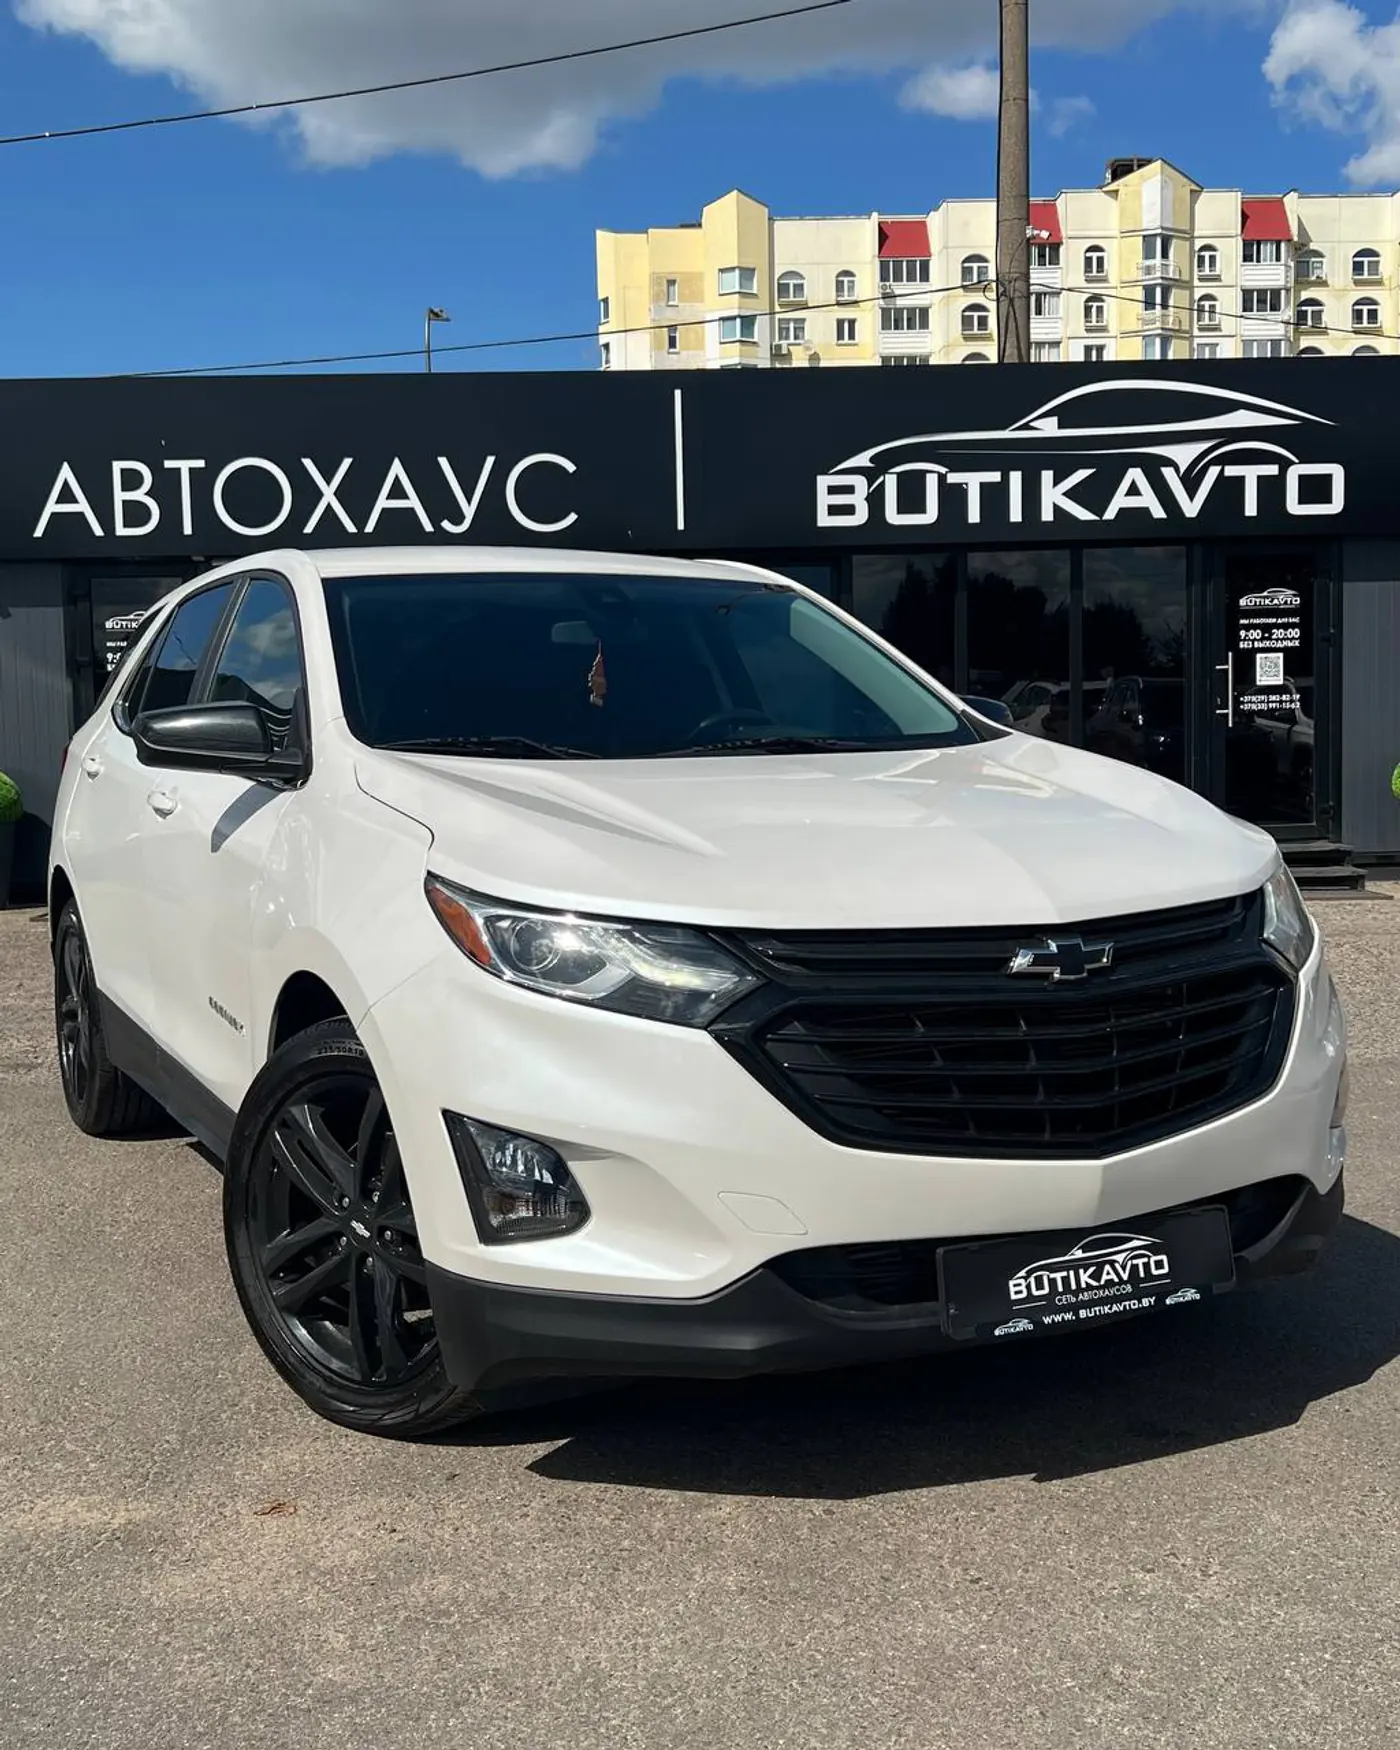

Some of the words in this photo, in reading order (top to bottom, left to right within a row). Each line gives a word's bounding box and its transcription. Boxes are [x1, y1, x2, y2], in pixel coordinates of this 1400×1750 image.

[33, 452, 579, 539] АВТОХАУС
[816, 462, 1346, 528] BUTIKAVTO
[1239, 597, 1300, 606] BUTIKAVTO
[1239, 629, 1262, 640] 9:00
[1271, 628, 1300, 639] 20:00
[1239, 640, 1253, 649] БЕЗ
[1253, 639, 1300, 648] ВЫХОДНЫХ
[1008, 1253, 1170, 1301] BUTIKAVTO
[1055, 1294, 1077, 1306] СЕТЬ
[1077, 1283, 1134, 1302] АВТОХАУСОВ
[1042, 1311, 1077, 1325] WWW.
[1078, 1296, 1156, 1319] BUTIKAVTO.BY
